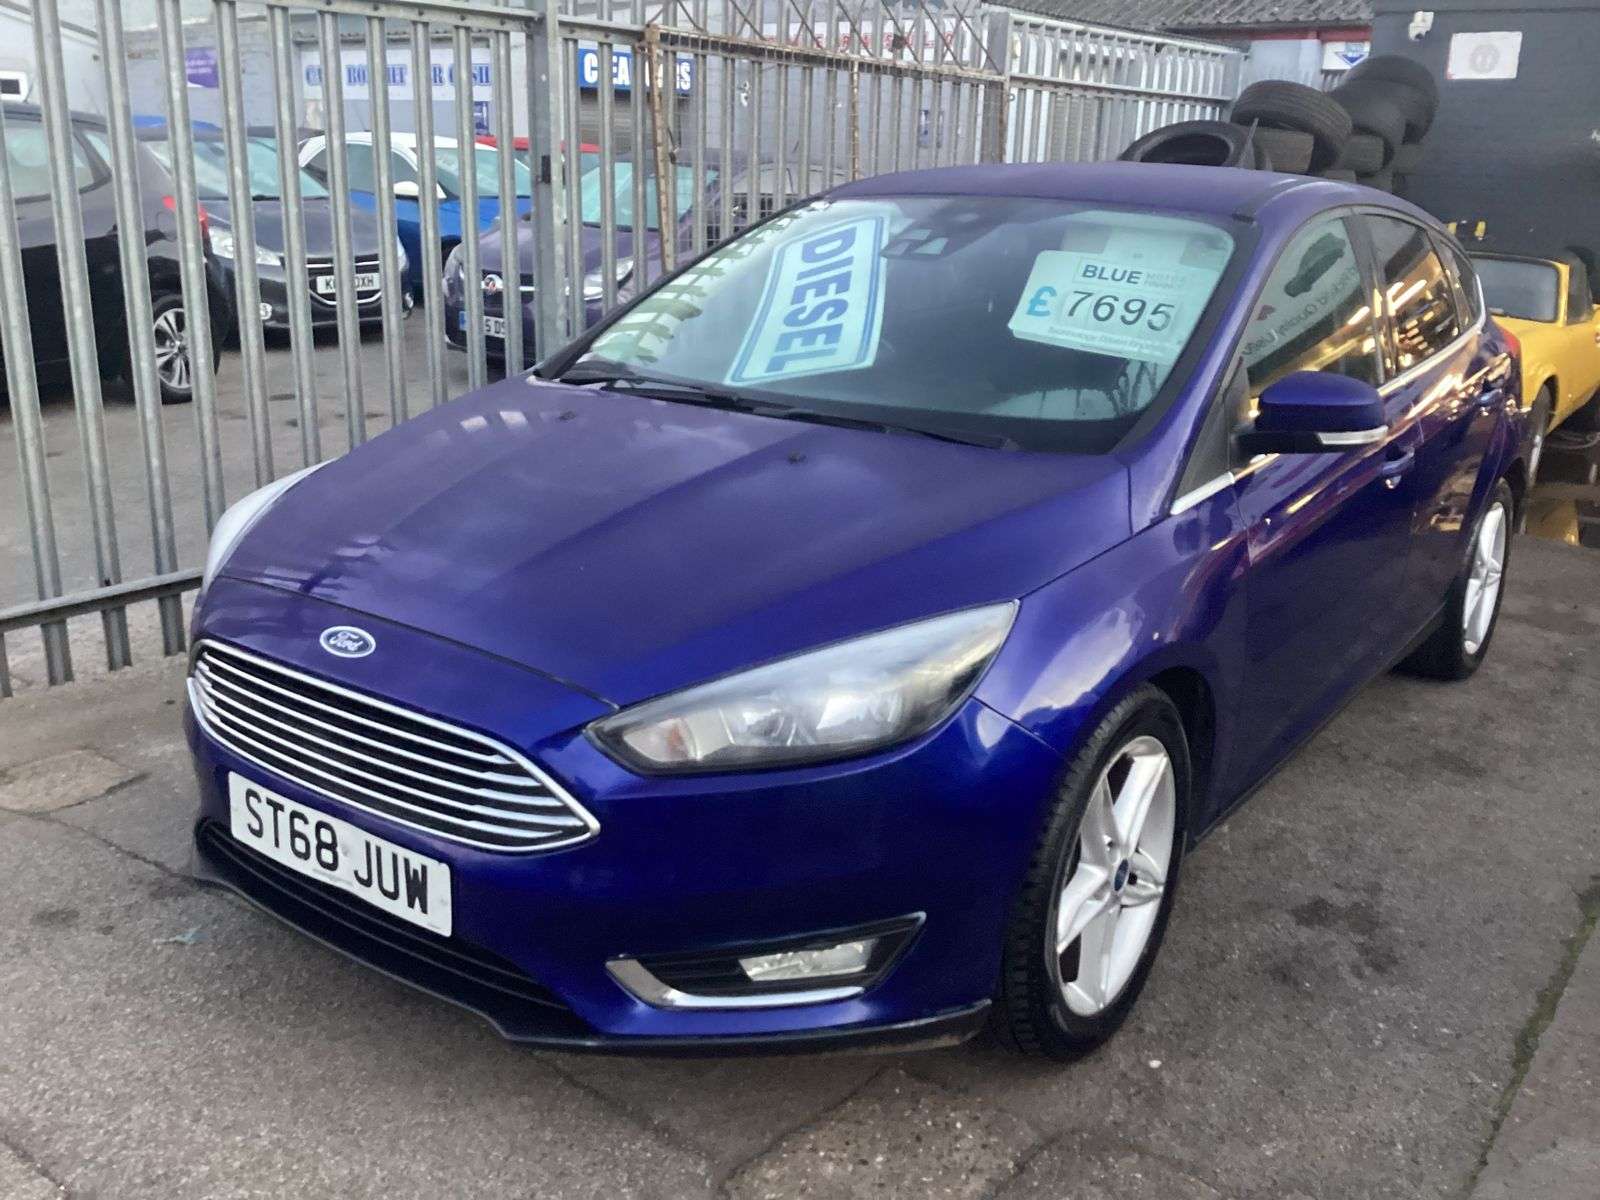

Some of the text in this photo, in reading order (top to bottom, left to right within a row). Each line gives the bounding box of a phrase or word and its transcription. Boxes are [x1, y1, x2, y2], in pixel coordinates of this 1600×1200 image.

[764, 226, 858, 373] DIESEL
[1067, 291, 1175, 332] 7695
[1082, 264, 1143, 285] BLUE
[245, 788, 428, 915] ST68 JUW
